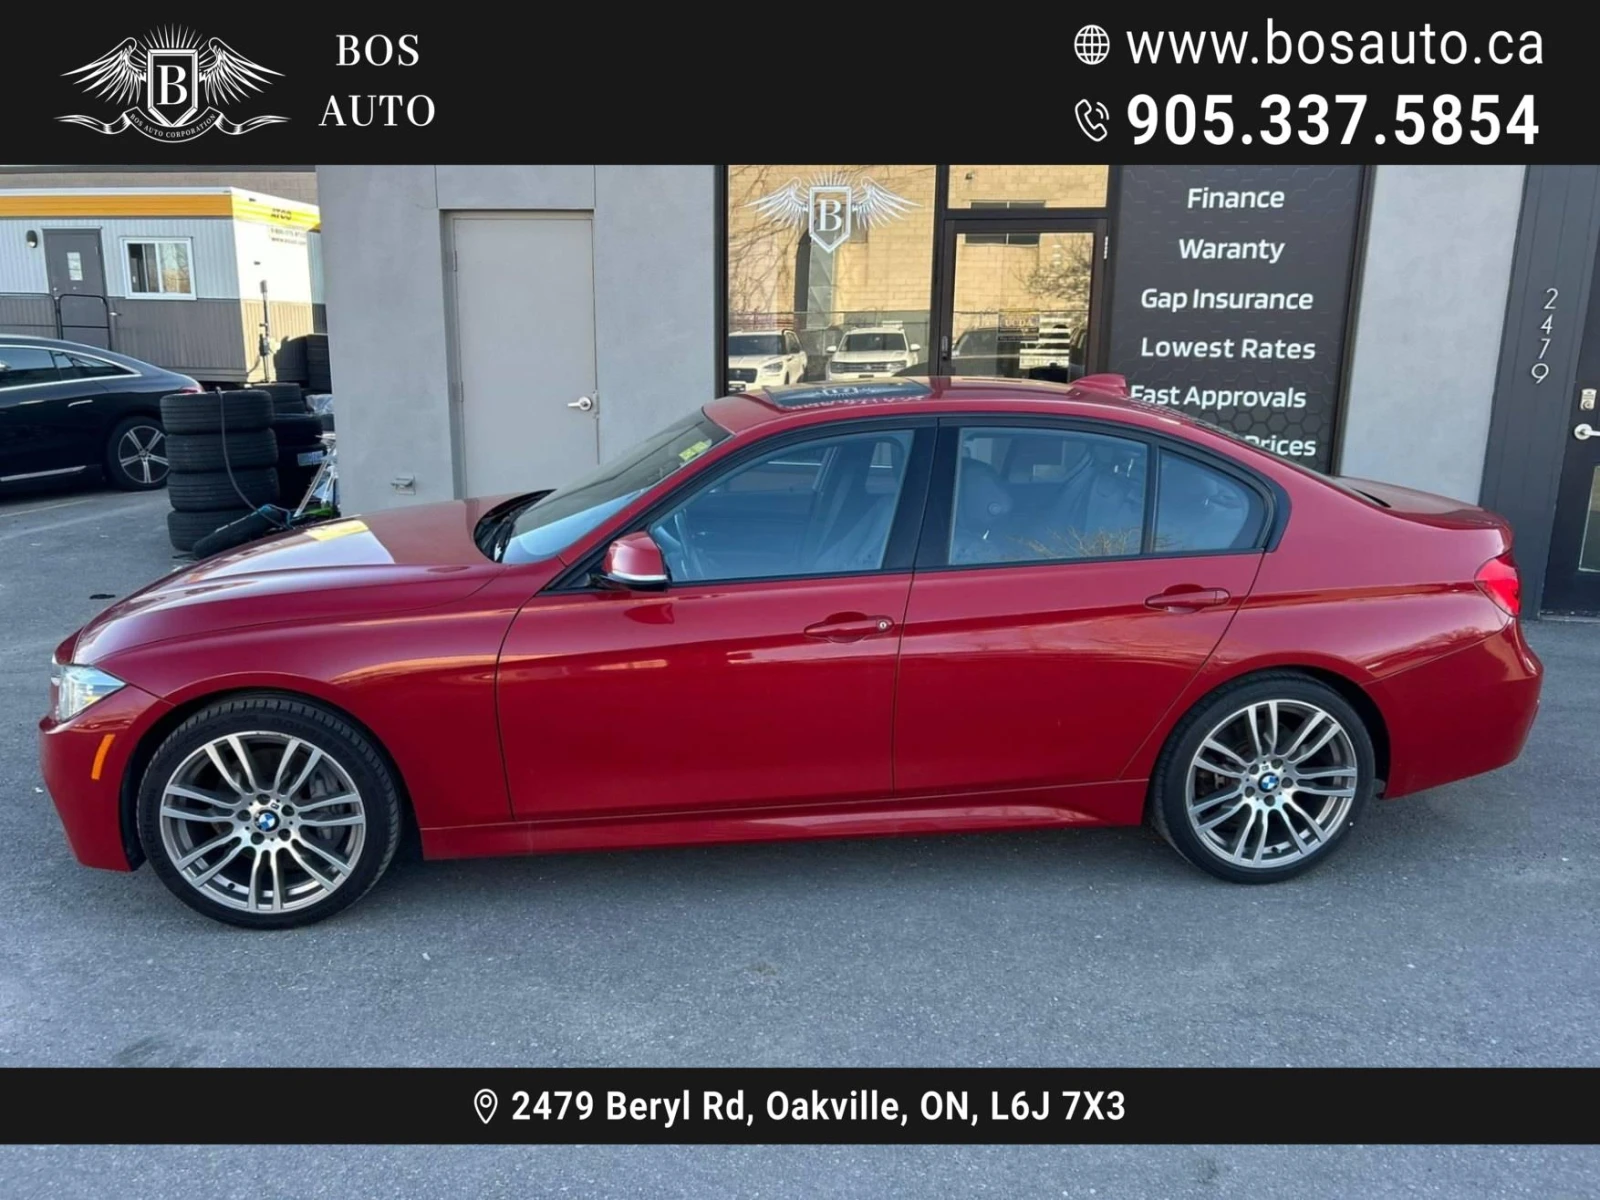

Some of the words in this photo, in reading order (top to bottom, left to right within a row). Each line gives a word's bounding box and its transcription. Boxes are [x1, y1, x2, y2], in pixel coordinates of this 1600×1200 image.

[1187, 187, 1285, 208] Finance
[815, 199, 842, 231] B
[1178, 239, 1286, 263] Waranty
[1141, 288, 1187, 312] Gap
[1193, 289, 1314, 310] Insurance
[1531, 287, 1559, 384] 2479
[1141, 337, 1235, 358] Lowest
[1241, 338, 1316, 360] Rates
[1130, 384, 1181, 405] Fast
[1183, 386, 1307, 411] Approvals
